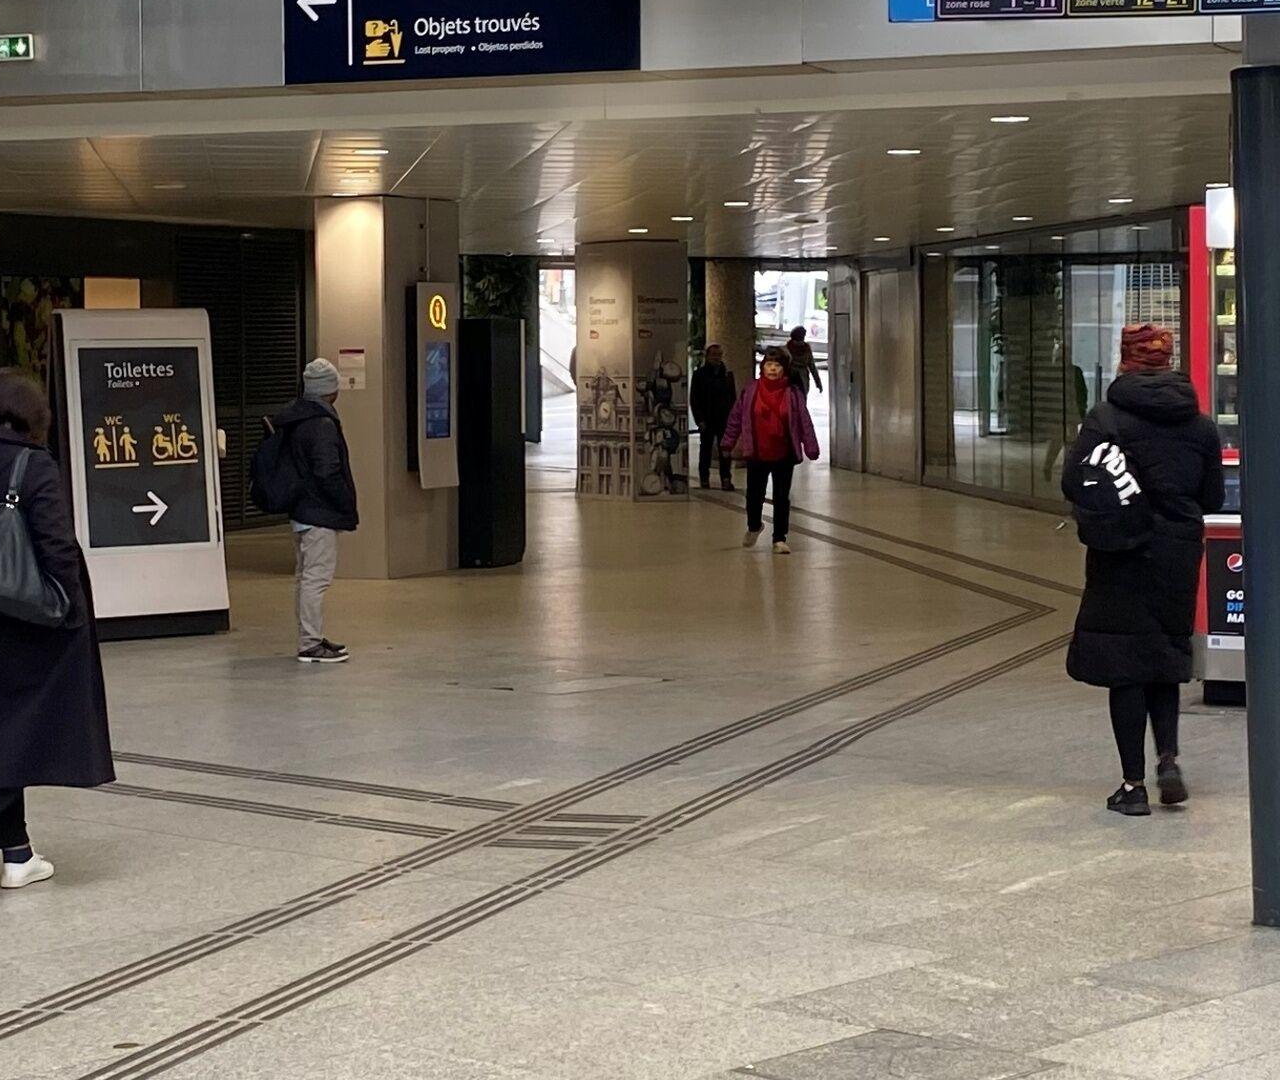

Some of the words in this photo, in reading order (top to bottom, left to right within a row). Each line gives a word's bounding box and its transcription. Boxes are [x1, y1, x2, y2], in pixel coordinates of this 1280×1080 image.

[414, 17, 470, 40] Objets
[474, 13, 540, 33] trouvés
[432, 45, 465, 55] property
[510, 41, 543, 51] perdidos
[104, 362, 174, 379] Toilettes
[107, 379, 134, 389] Toilets
[104, 416, 123, 425] WC
[162, 413, 181, 423] WC
